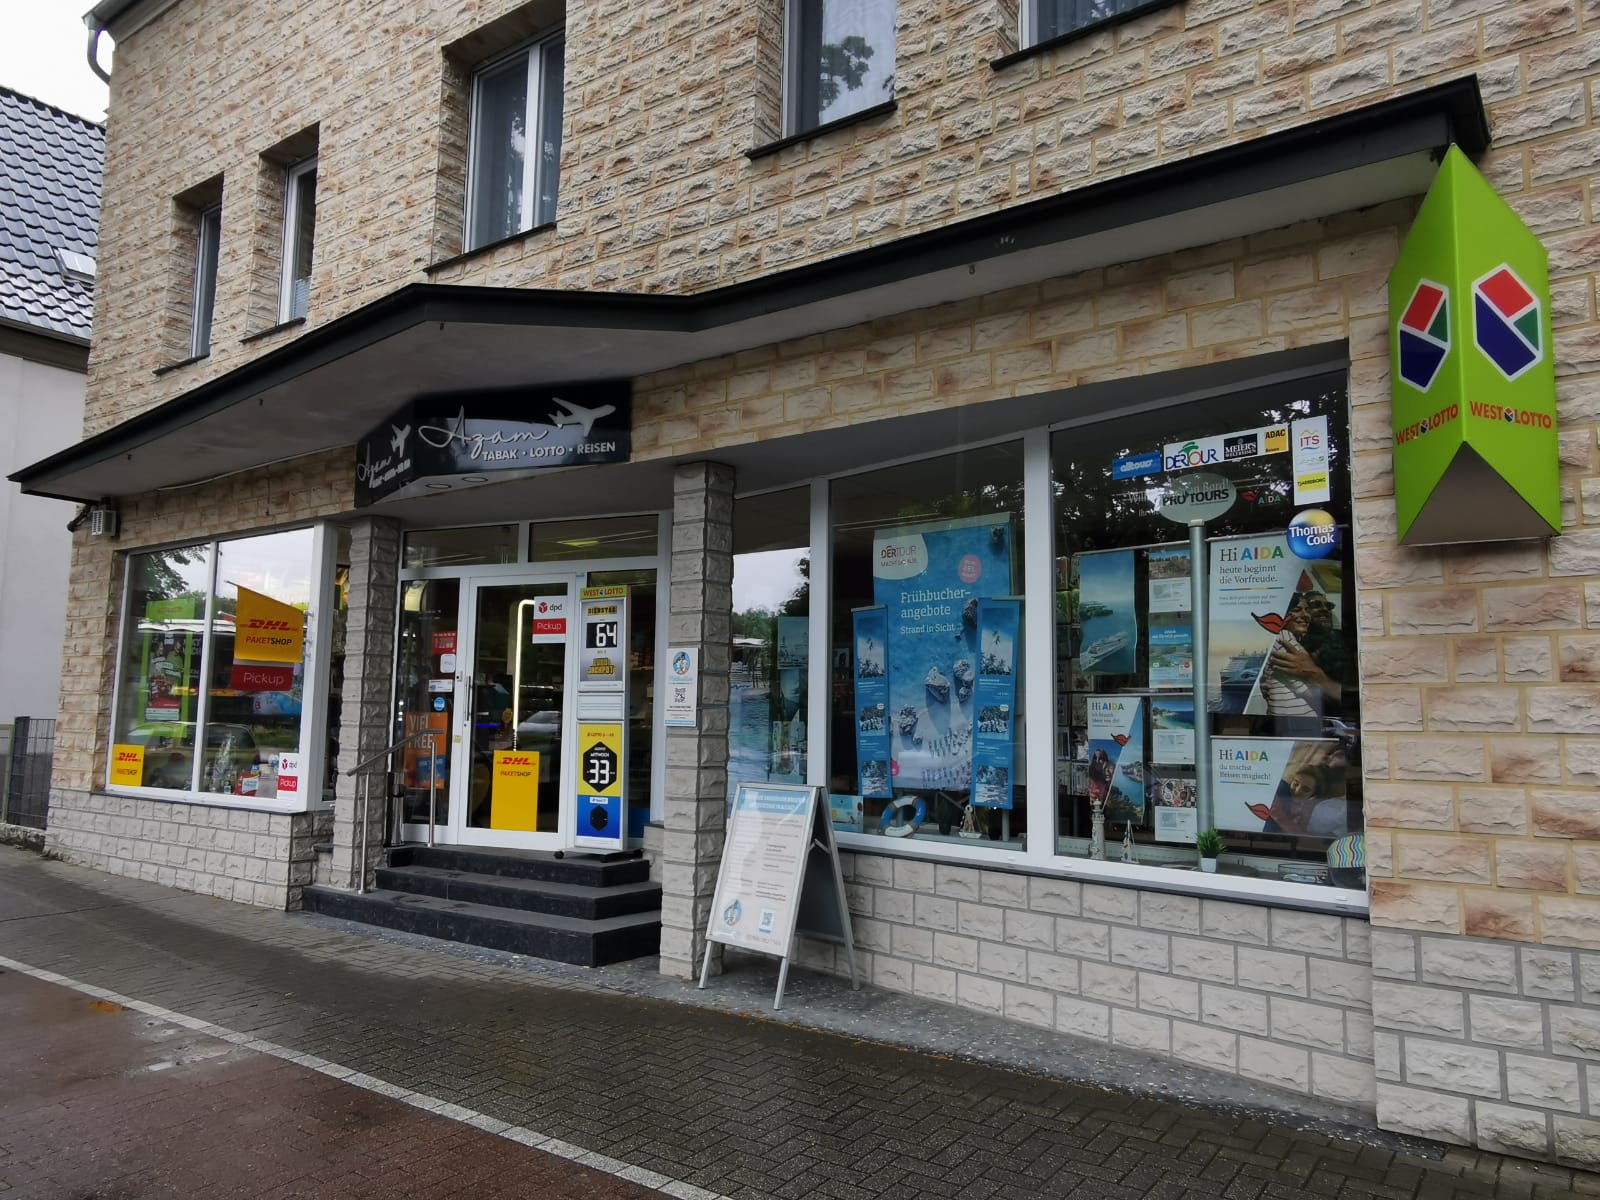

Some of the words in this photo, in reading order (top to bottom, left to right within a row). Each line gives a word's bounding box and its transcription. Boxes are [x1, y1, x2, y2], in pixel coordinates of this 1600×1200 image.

[1470, 401, 1503, 420] WEST
[1514, 409, 1552, 429] LOTTO
[1396, 423, 1420, 445] WEST
[1428, 404, 1459, 431] LOTTO
[418, 405, 548, 460] Azam
[1265, 429, 1286, 440] ADAC
[1300, 435, 1320, 447] ITS
[481, 449, 518, 462] TABAK
[529, 446, 565, 459] LOTTO
[577, 442, 616, 455] REISEN
[1165, 446, 1219, 471] DERTOUR
[1190, 489, 1230, 503] TOURS
[1288, 524, 1334, 539] Thomas
[1306, 533, 1334, 546] Cook
[1219, 547, 1238, 562] Hi
[1240, 546, 1284, 561] AIDA
[1219, 566, 1242, 574] heute
[1245, 564, 1277, 575] beginnt
[1219, 576, 1232, 585] die
[1235, 574, 1278, 585] Vorfreude.
[583, 590, 600, 598] WEST
[604, 588, 623, 596] LOTTO
[901, 587, 971, 604] Frühbucher-
[549, 603, 562, 613] dpd
[901, 604, 951, 620] angebote
[537, 622, 562, 632] Pickup
[900, 624, 925, 635] Strand
[926, 624, 934, 633] in
[935, 623, 954, 634] Sicht
[246, 635, 293, 646] PAKETSHOP
[595, 624, 617, 648] 64
[243, 671, 284, 687] Pickup
[1103, 703, 1124, 711] AIDA
[502, 757, 531, 766] DHL
[1219, 749, 1233, 760] Hi
[1235, 750, 1269, 761] AIDA
[589, 759, 610, 784] 33
